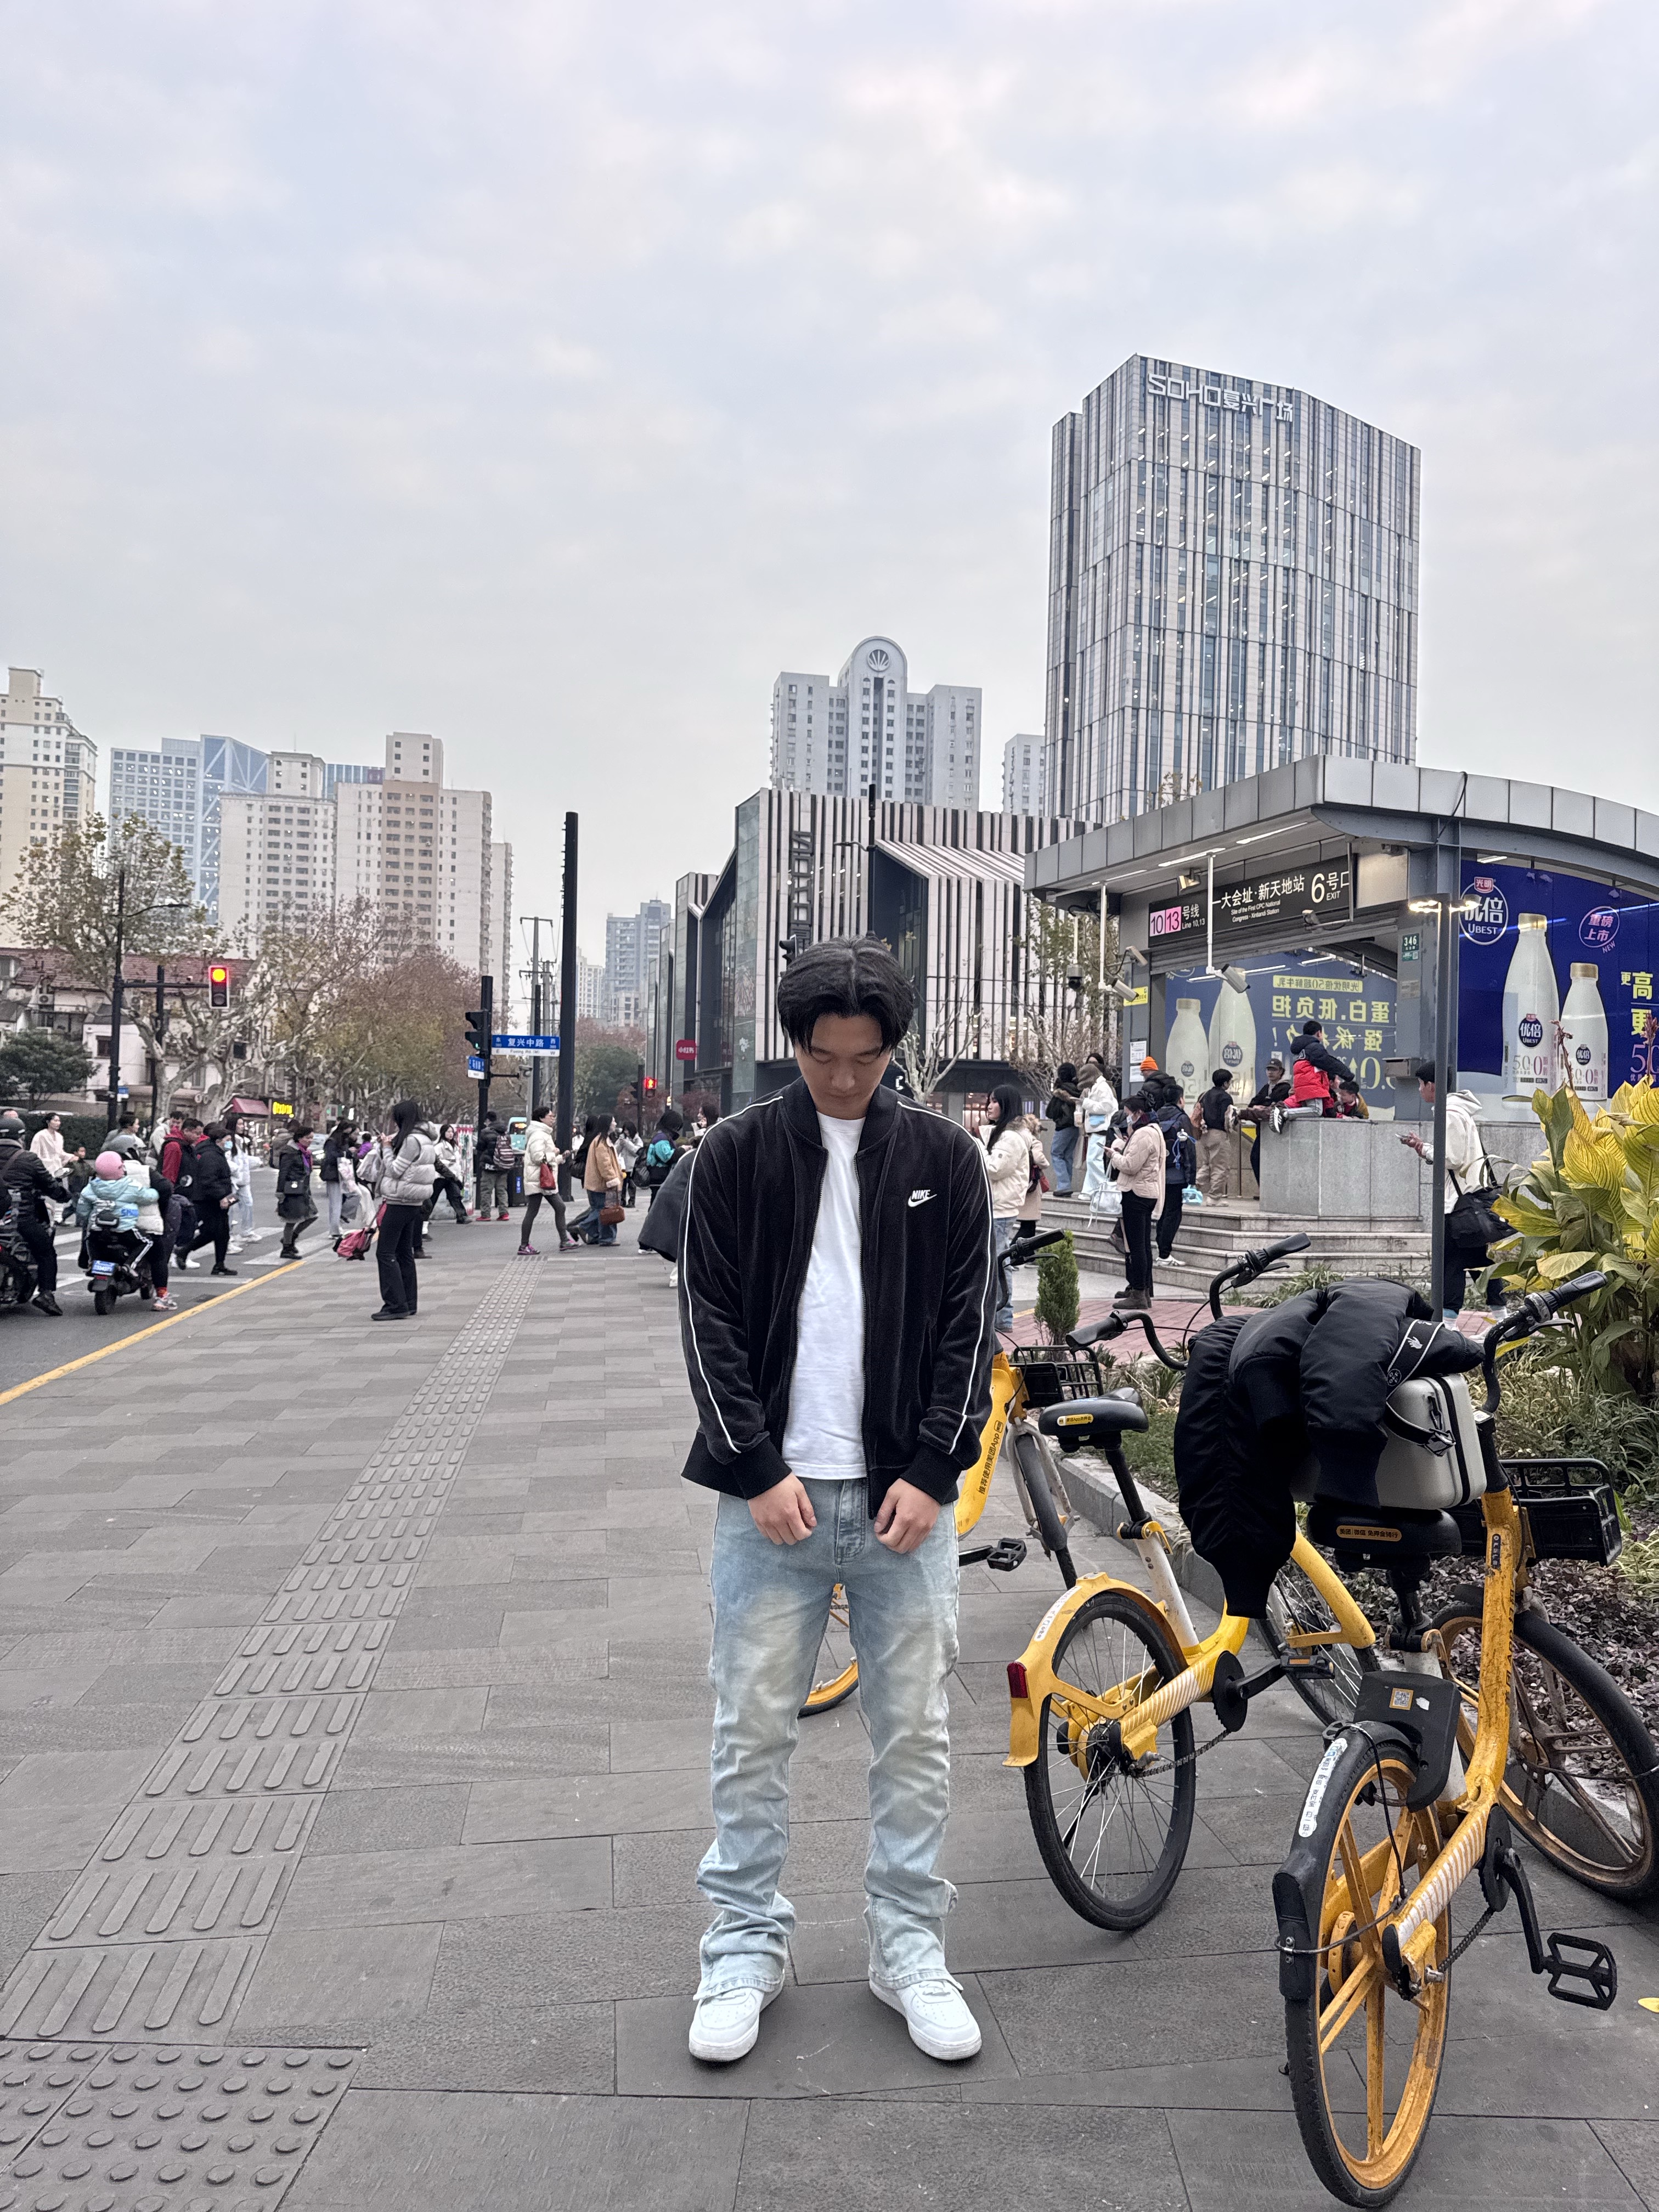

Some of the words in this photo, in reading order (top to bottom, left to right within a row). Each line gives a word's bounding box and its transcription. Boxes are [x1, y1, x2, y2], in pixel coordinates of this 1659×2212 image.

[1148, 373, 1293, 422] SOHO复兴广场
[1476, 879, 1492, 888] 光明
[1326, 890, 1341, 901] EXIT
[1265, 900, 1281, 909] National
[1182, 904, 1199, 920] 号线
[1151, 915, 1163, 934] 10
[1167, 911, 1180, 932] 13
[1193, 918, 1205, 927] 10,13
[1404, 935, 1417, 946] 346
[1584, 928, 1610, 941] 上市
[1602, 940, 1616, 953] NEW
[1520, 1023, 1541, 1037] 优倍
[508, 1038, 544, 1047] 复兴中路
[911, 1189, 931, 1200] NIKE
